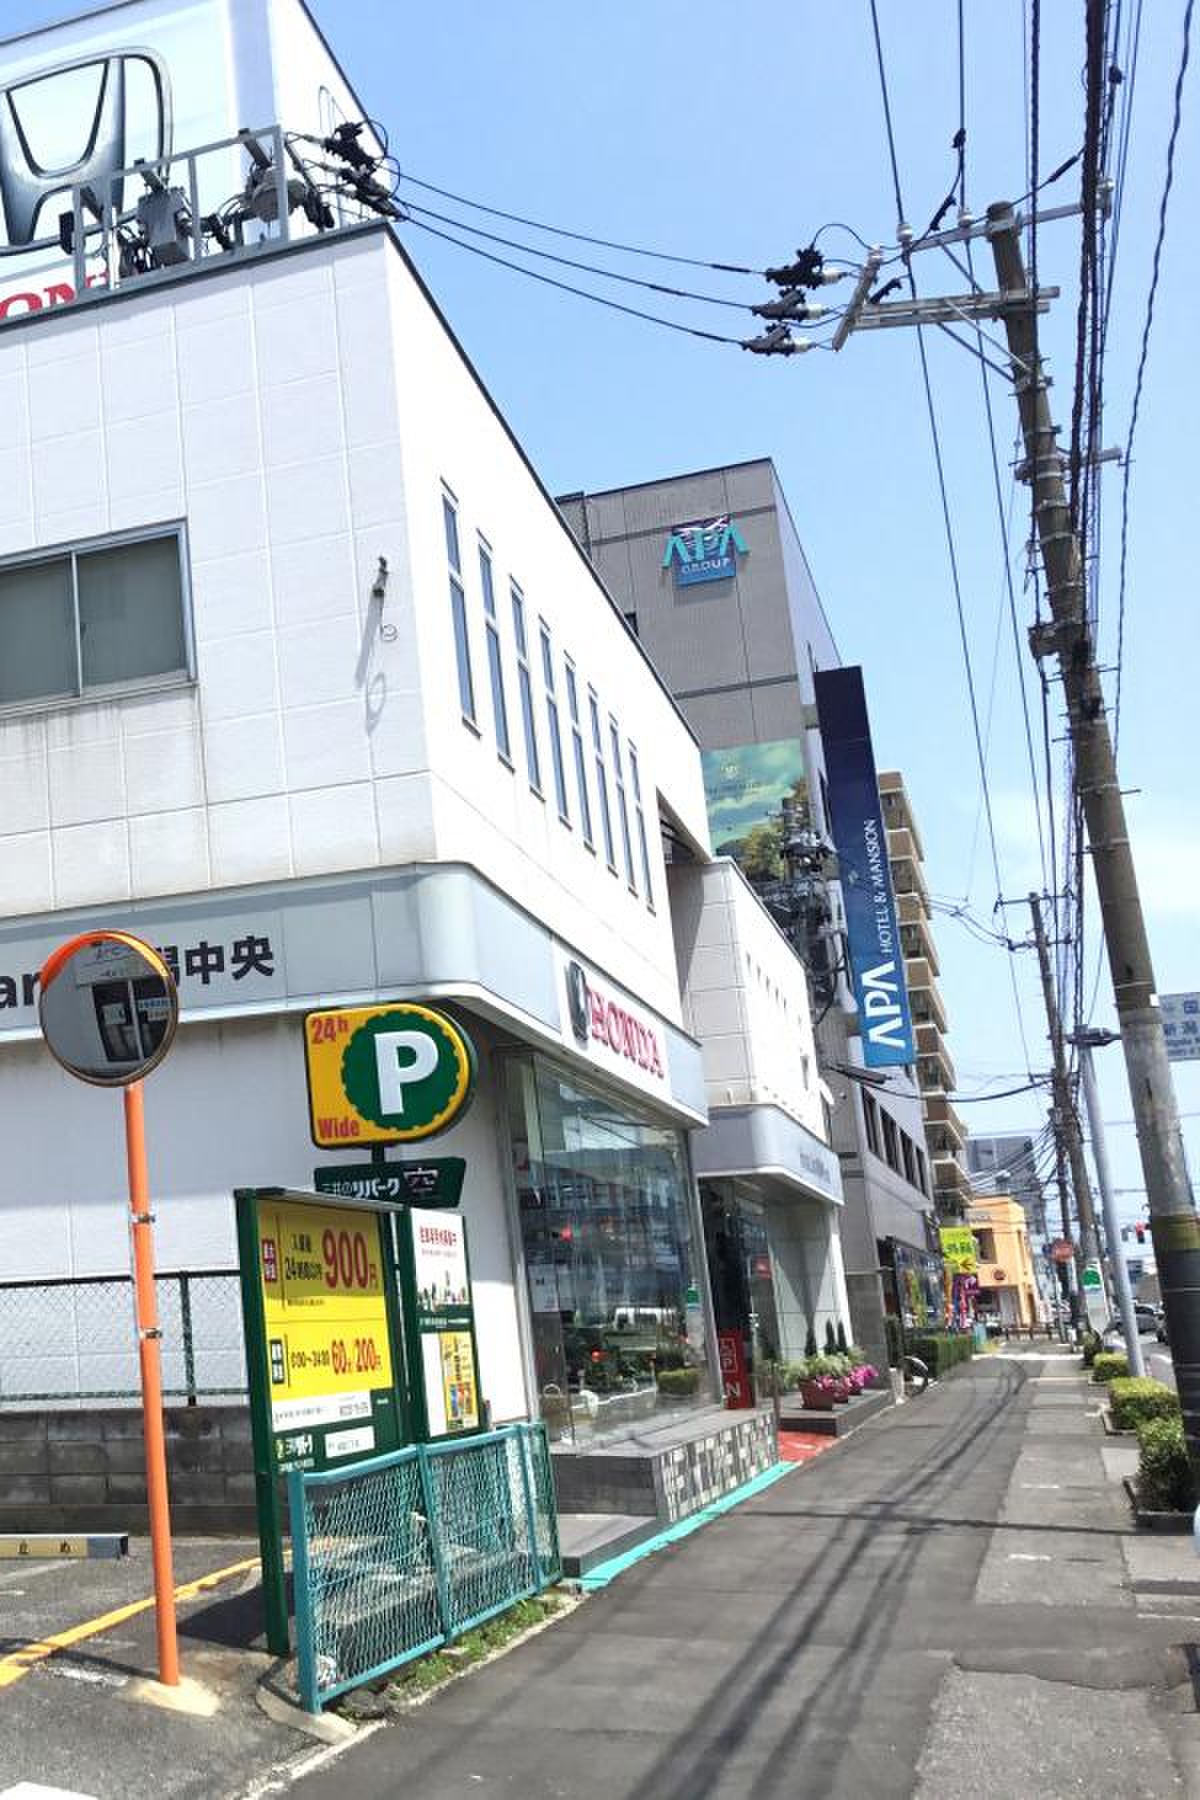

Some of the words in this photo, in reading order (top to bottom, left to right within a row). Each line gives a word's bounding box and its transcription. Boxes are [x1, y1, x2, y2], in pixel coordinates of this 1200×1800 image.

[863, 818, 885, 889] MANSION
[875, 908, 893, 954] HOTEL
[860, 960, 907, 1050] APA
[374, 1030, 439, 1116] P
[318, 1116, 361, 1140] Wide
